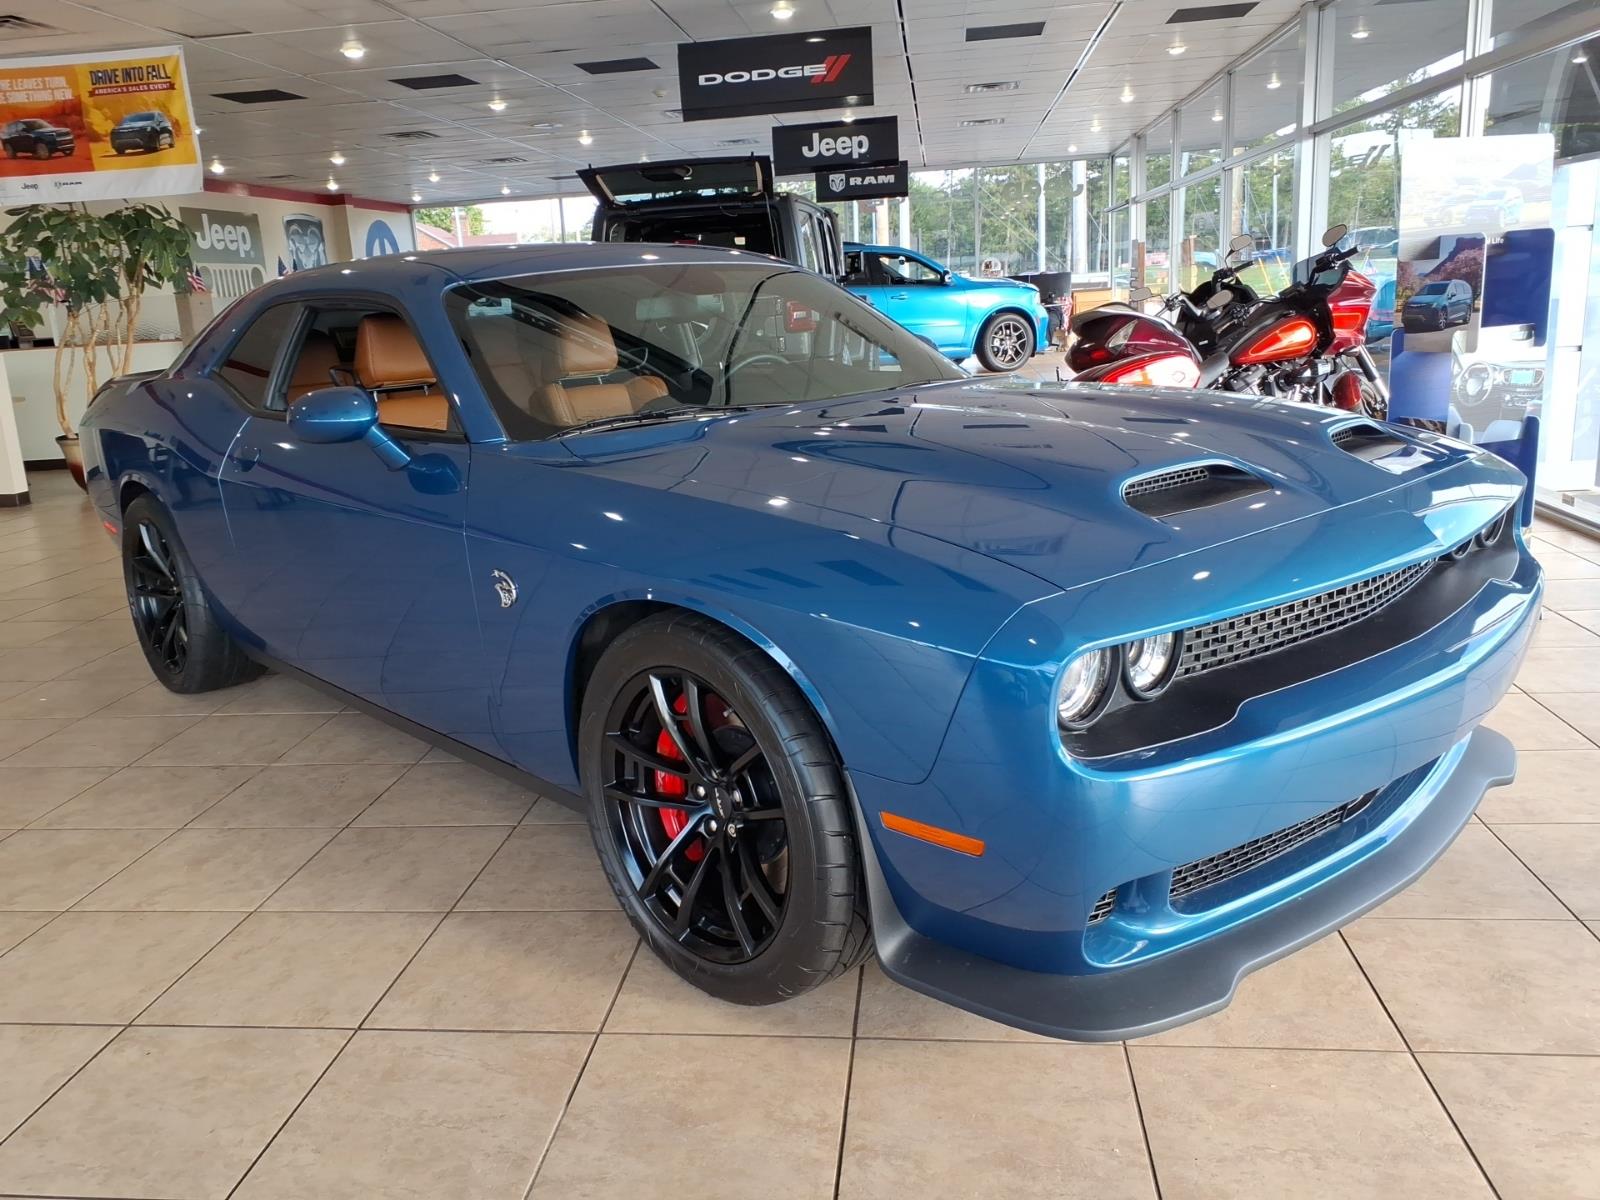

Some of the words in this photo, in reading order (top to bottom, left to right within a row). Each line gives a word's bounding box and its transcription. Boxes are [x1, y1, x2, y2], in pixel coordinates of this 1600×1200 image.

[89, 68, 120, 86] DRIVE
[121, 66, 144, 83] INTO
[146, 63, 172, 81] FALL
[698, 64, 827, 86] DODGE
[94, 87, 127, 95] AMERICA'S
[128, 84, 148, 92] SALES
[149, 82, 171, 90] EVENT
[801, 132, 869, 159] Jeep
[849, 174, 895, 186] RAM
[196, 213, 252, 258] Jeep
